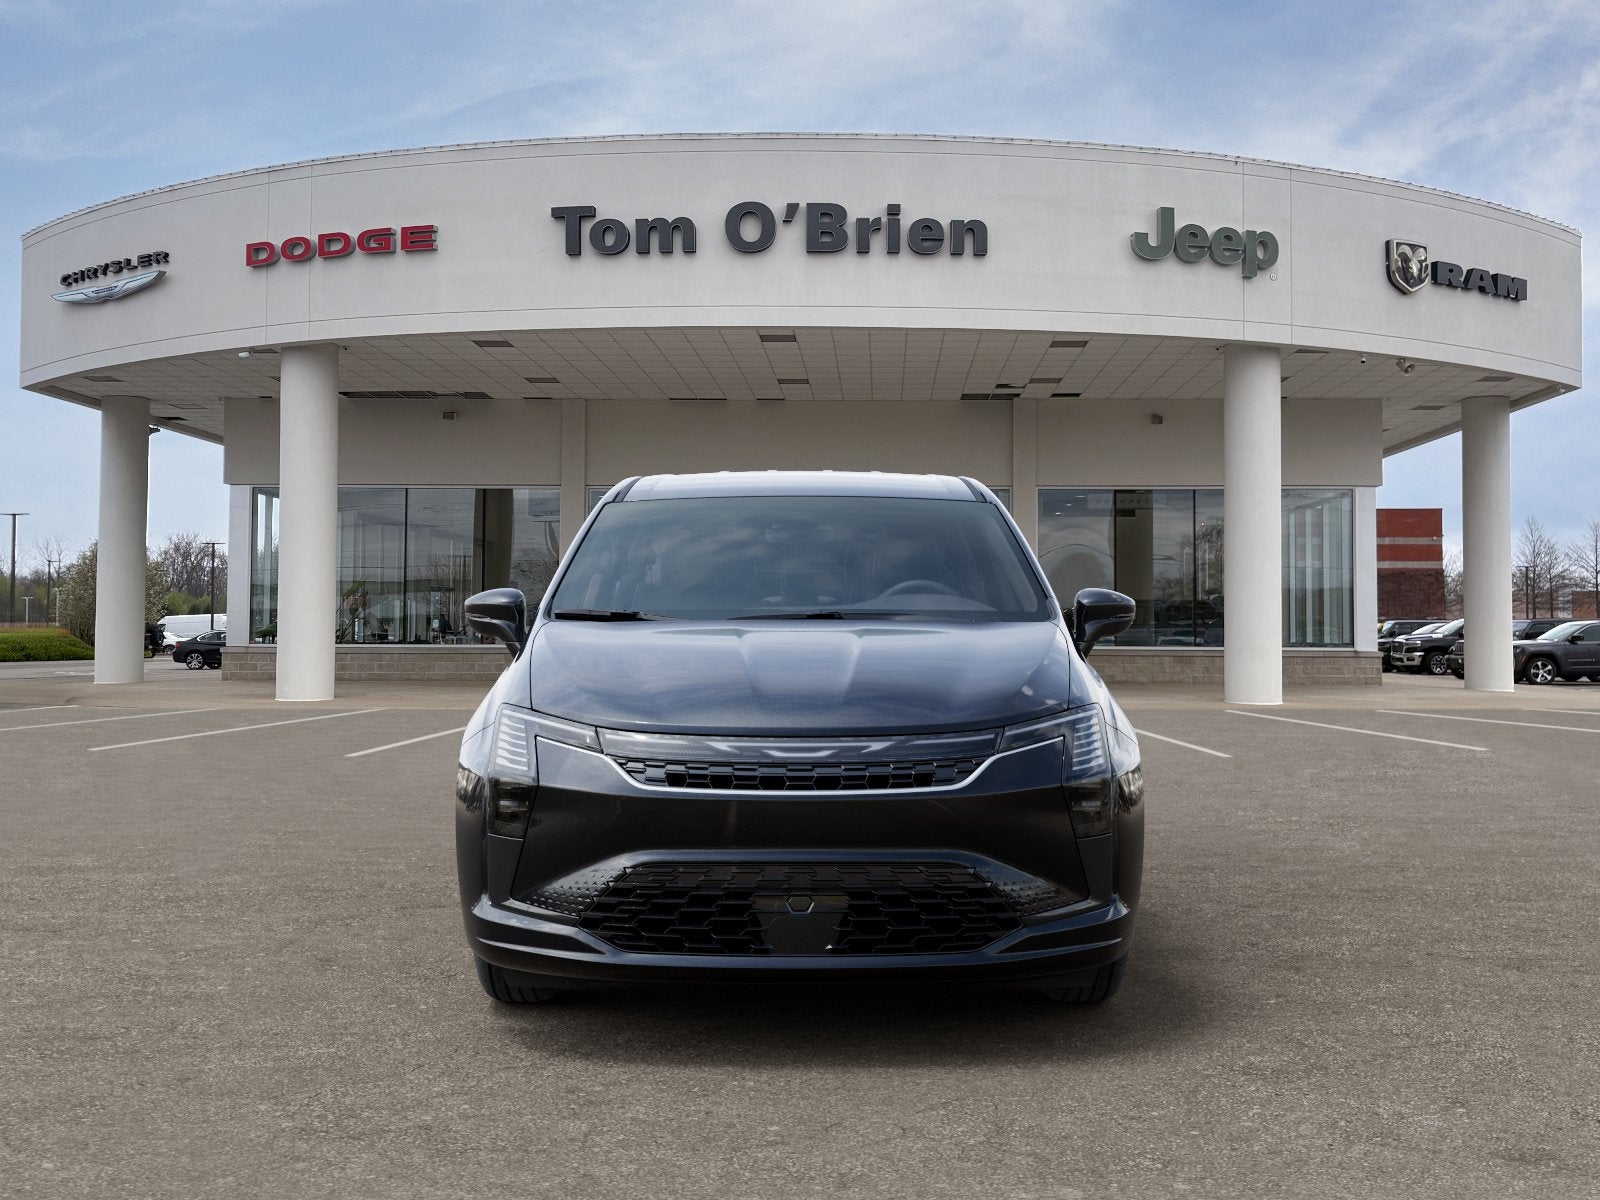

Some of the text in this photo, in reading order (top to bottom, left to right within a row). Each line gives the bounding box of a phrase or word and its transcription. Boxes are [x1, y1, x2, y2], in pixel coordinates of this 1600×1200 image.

[246, 225, 438, 268] DODGE
[551, 201, 988, 256] Tom O'Brien
[1131, 207, 1279, 278] Jeep
[60, 251, 169, 286] CHRYSLER
[1431, 261, 1527, 301] RAM
